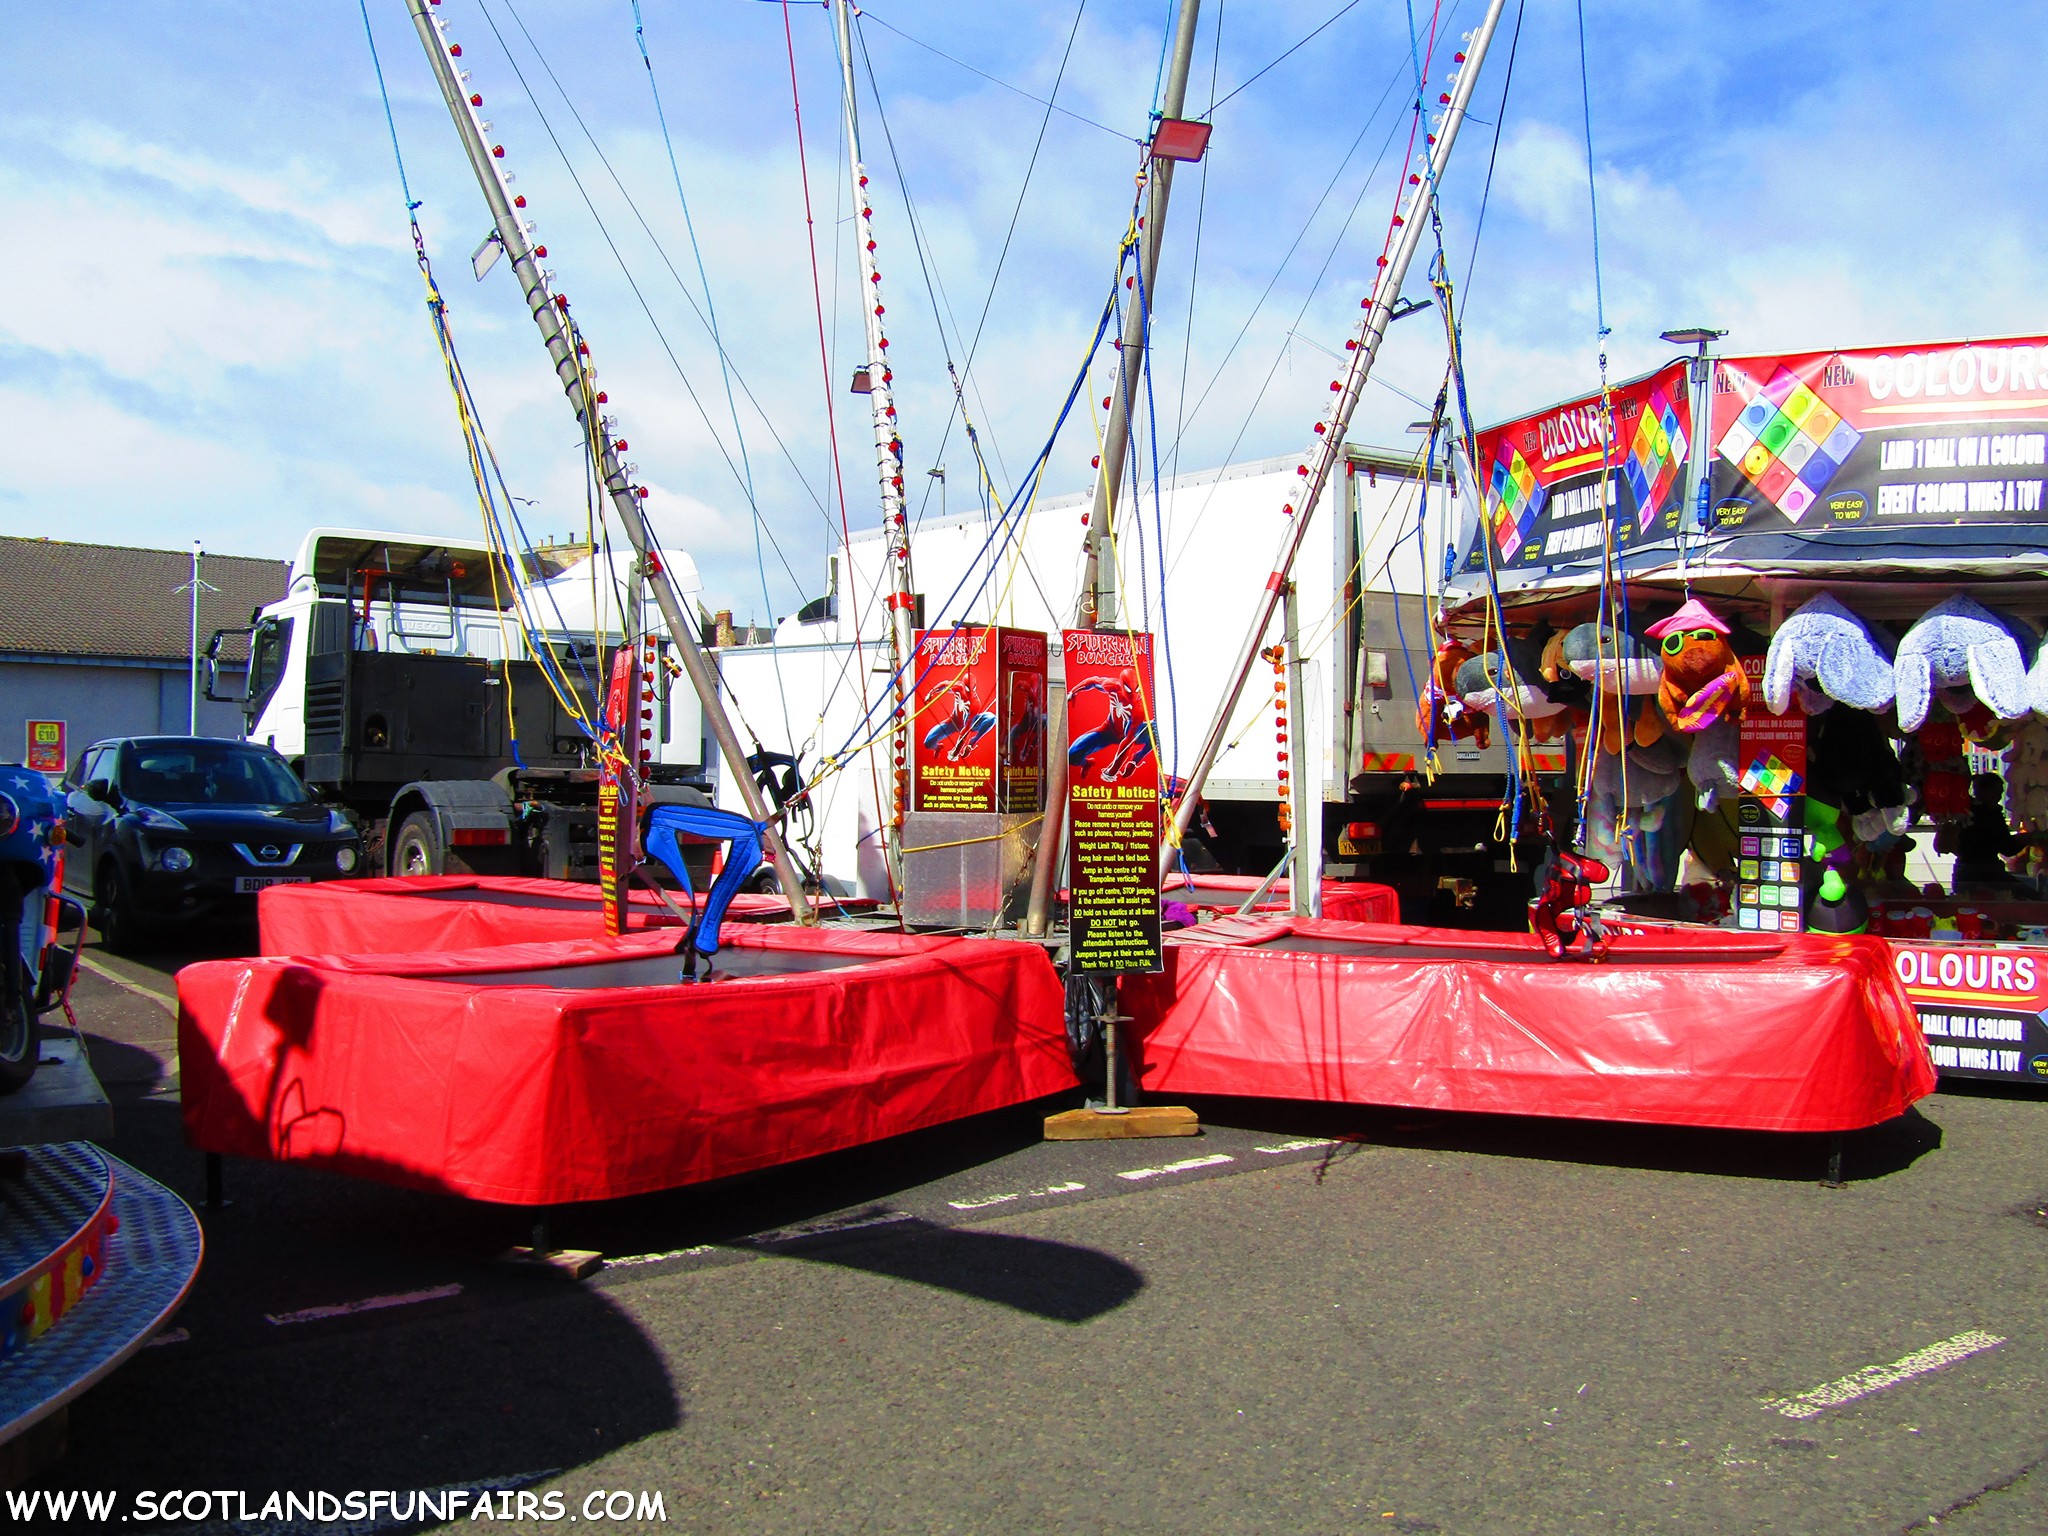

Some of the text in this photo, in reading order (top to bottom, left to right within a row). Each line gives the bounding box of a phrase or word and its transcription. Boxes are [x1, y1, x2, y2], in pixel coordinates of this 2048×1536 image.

[1715, 372, 1747, 394] NEW
[1823, 365, 1856, 388] NEW
[1523, 432, 1538, 452] NEW
[1880, 434, 2046, 470] LAND 1 BALL ON A COLOUR
[1830, 500, 1863, 510] VERY EASY
[1878, 480, 2043, 515] EVERY COLOUR WINS A TOY
[1732, 507, 1747, 515] EASY
[1844, 511, 1860, 519] WIN
[1730, 516, 1743, 524] PLAY
[1077, 650, 1137, 666] BUNGEES
[922, 766, 990, 777] Safety Notice
[1026, 766, 1044, 776] Notie
[1073, 785, 1155, 800] Safety Notice
[1079, 842, 1096, 850] Weight
[1112, 842, 1124, 850] 70kg
[1923, 1014, 1949, 1036] BALL
[1950, 1015, 1966, 1037] ON
[1966, 1017, 1976, 1038] A
[1977, 1017, 2022, 1041] COLOUR
[1959, 1047, 2021, 1072] WINS A TOY
